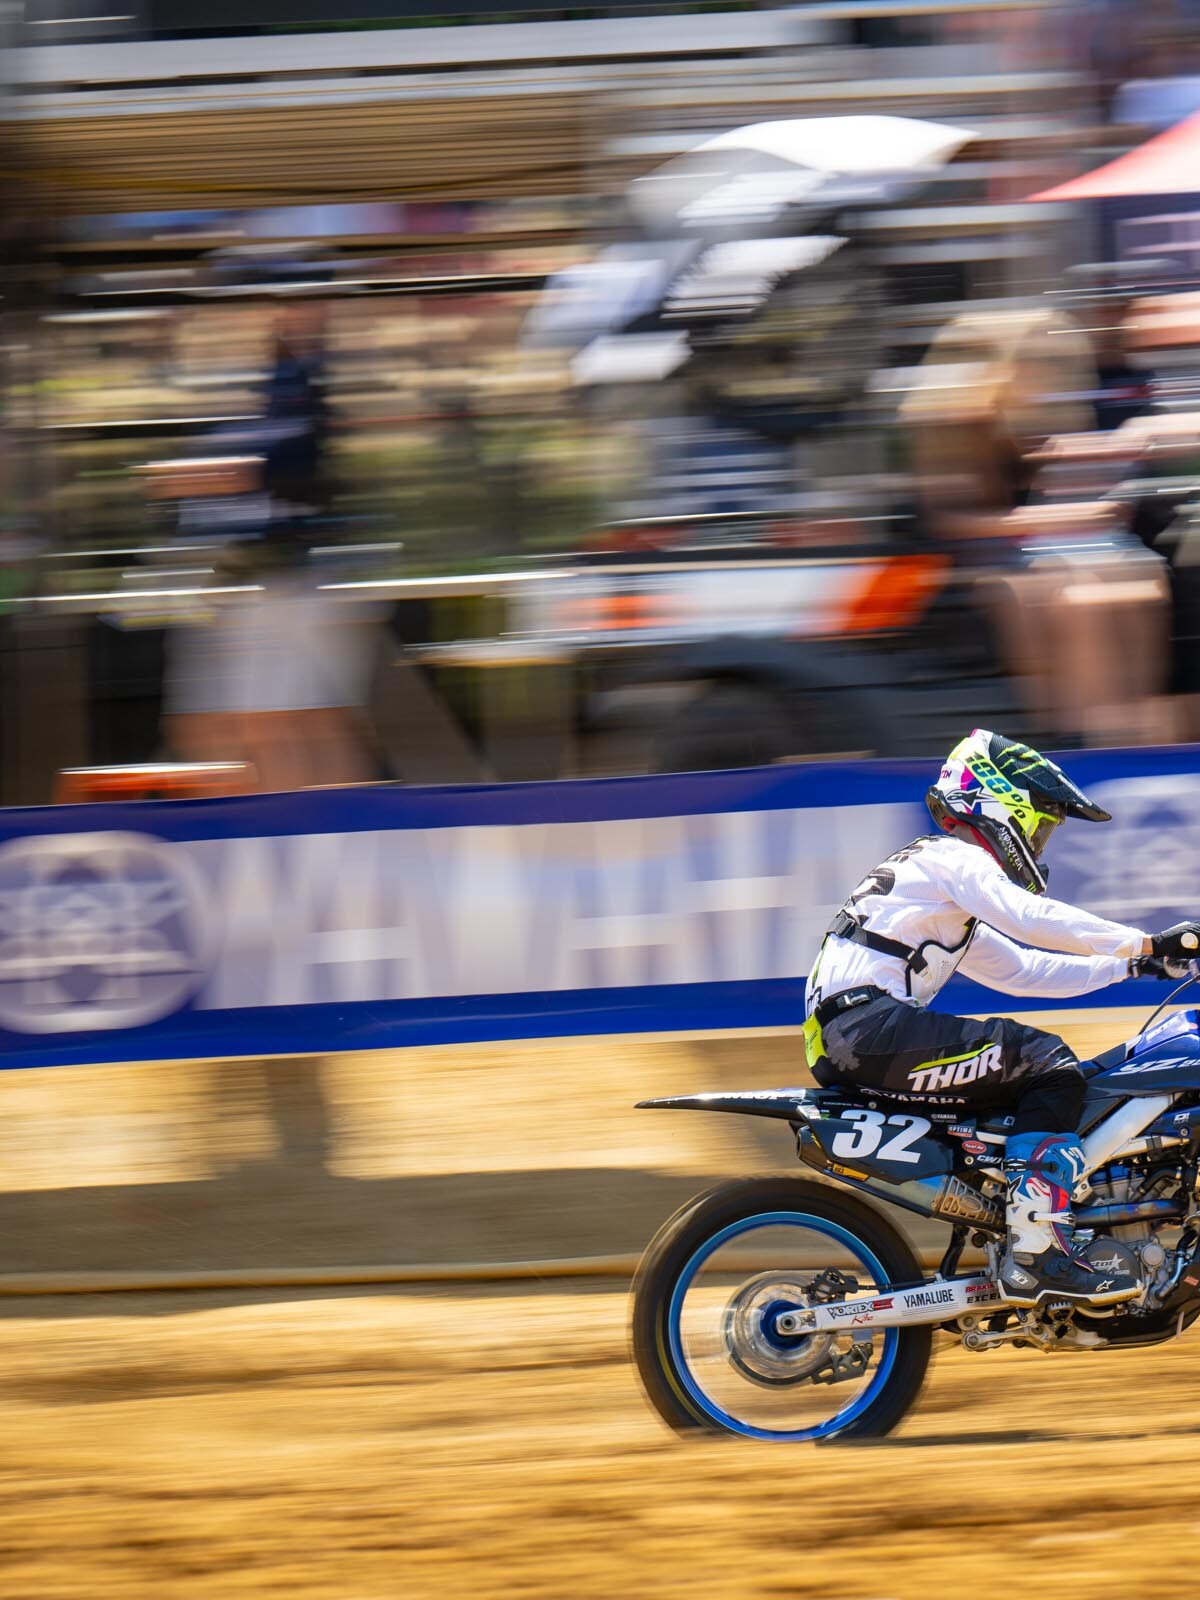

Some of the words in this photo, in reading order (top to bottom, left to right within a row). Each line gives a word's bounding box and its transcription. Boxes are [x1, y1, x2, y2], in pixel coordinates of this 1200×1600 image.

[965, 751, 1026, 819] 100%
[1000, 826, 1024, 871] MONSTER
[907, 1046, 1002, 1092] THOR
[832, 1109, 932, 1164] 32
[948, 1126, 973, 1134] OPTIMA
[903, 1289, 954, 1308] YAMALUBE
[965, 1283, 995, 1293] BRAKIN
[827, 1300, 875, 1319] VORTEX
